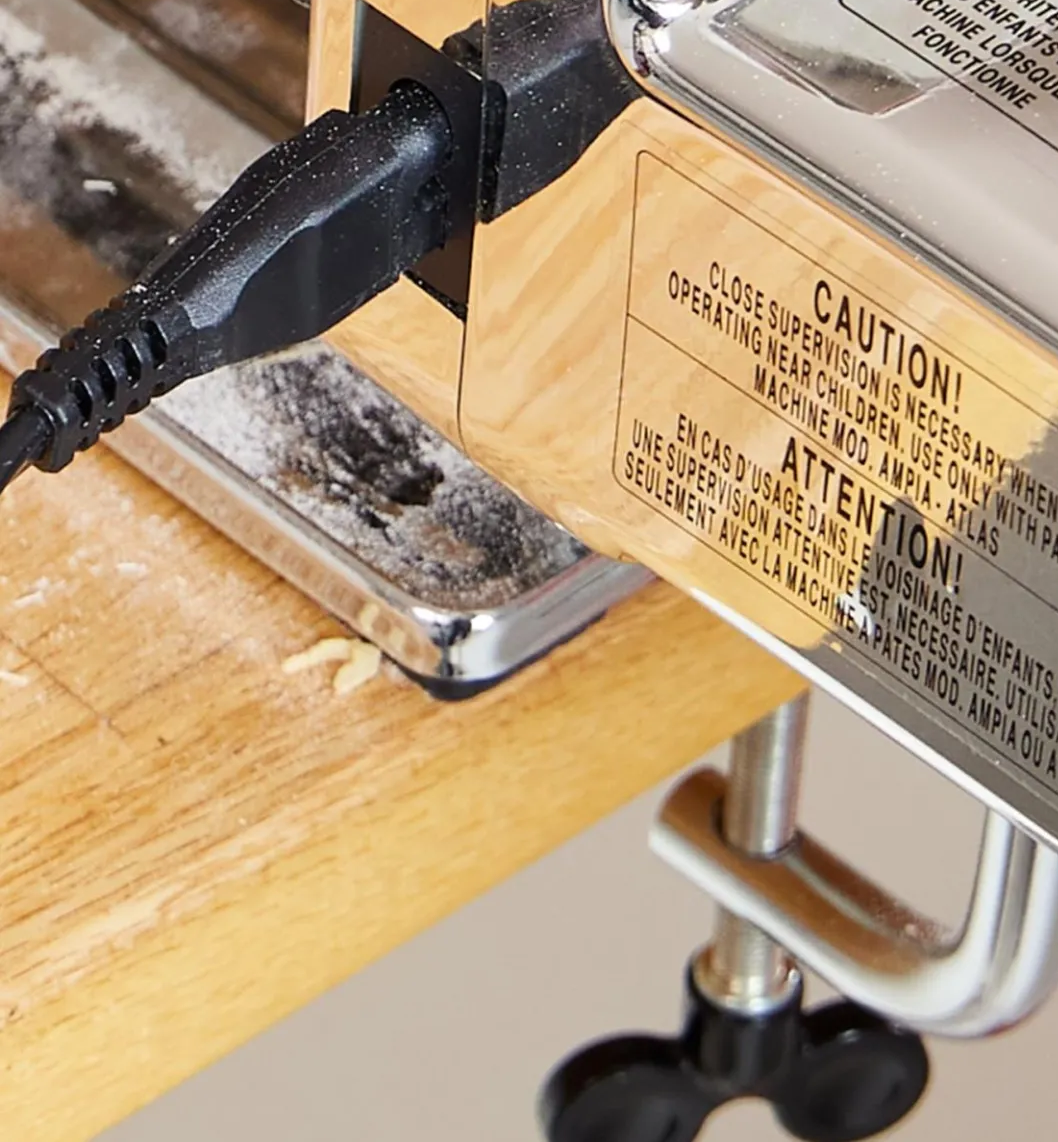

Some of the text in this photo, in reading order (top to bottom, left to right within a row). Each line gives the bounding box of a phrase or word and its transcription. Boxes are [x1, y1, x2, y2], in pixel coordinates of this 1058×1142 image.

[911, 24, 1038, 110] FONCTIONNE
[668, 270, 763, 356] OPERATING
[766, 335, 812, 390] NEAR
[816, 369, 905, 454] CHILDREN.
[910, 432, 944, 480] USE
[947, 459, 992, 511] ONLY
[996, 491, 1038, 546] WITH
[709, 261, 1058, 523] CLOSE SUPERVISION IS NECESSARY WHEN
[753, 363, 830, 440] MACHINE
[831, 417, 873, 472] MOD.
[878, 450, 932, 511] AMPIA
[945, 497, 1000, 557] ATLAS
[813, 279, 963, 415] CAUTION!
[624, 450, 717, 535] SEULEMENT
[718, 516, 760, 566] AVEC
[762, 544, 782, 583] LA
[785, 560, 856, 635] MACHINE
[858, 616, 869, 645] A
[872, 623, 922, 681] PATES
[924, 659, 963, 712] MOD.
[967, 692, 1016, 750] AMPIA
[1021, 729, 1044, 768] OU
[632, 418, 664, 464] UNE
[665, 442, 770, 537] SUPERVISION
[771, 517, 855, 598] ATTENTIVE
[896, 603, 1000, 701] NECESSAIRE.
[676, 412, 1058, 704] EN CAS D'USAGE DANS LE VOISINAGE D'ENFANTS,
[780, 435, 964, 596] ATTENTION!
